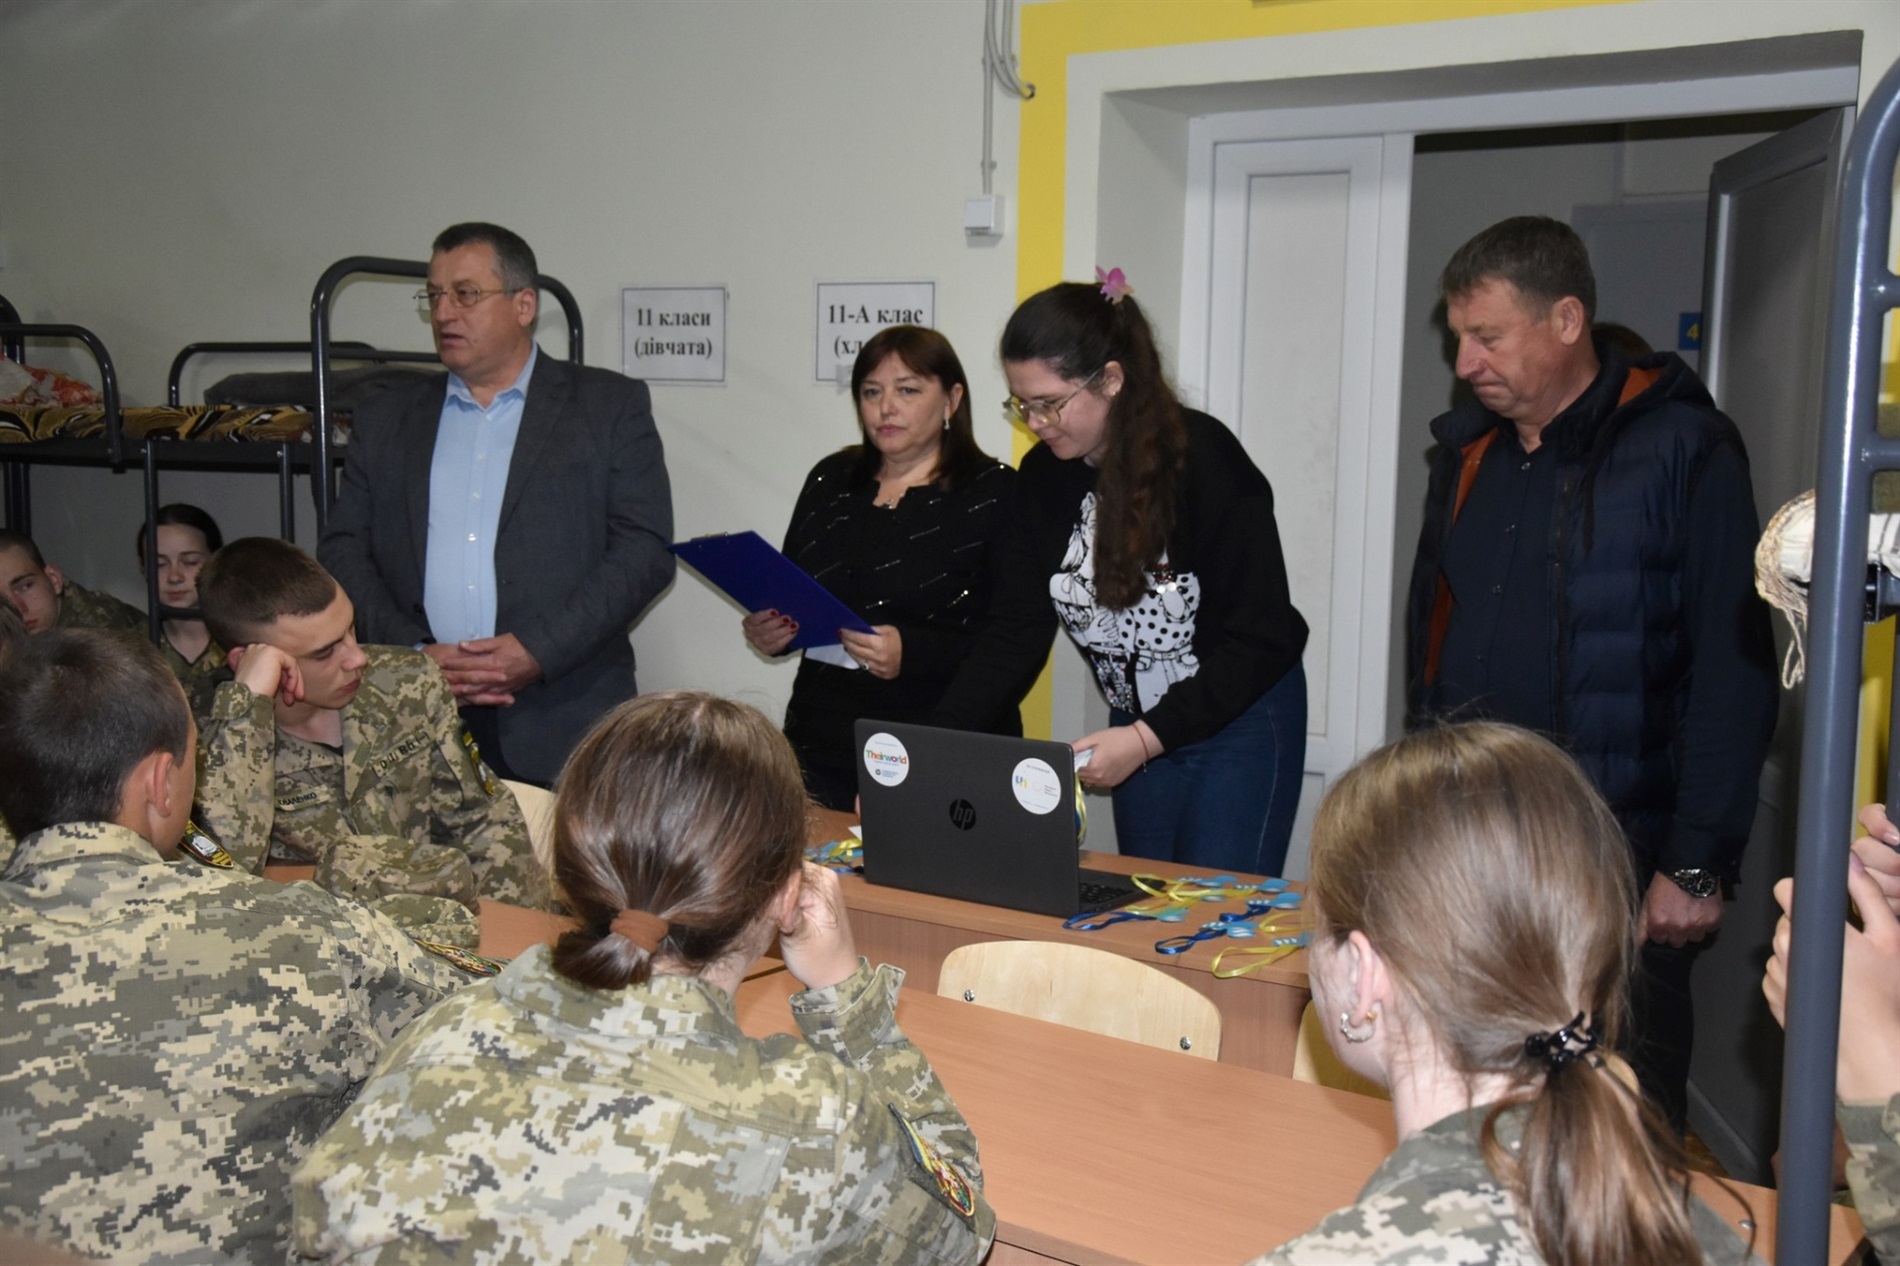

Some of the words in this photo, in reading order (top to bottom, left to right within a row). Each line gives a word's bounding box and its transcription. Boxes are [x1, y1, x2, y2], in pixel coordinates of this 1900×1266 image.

[637, 308, 652, 326] 11
[659, 312, 711, 327] класи
[828, 304, 870, 324] 11-А
[877, 308, 923, 324] клас
[634, 337, 713, 360] (дівчата)
